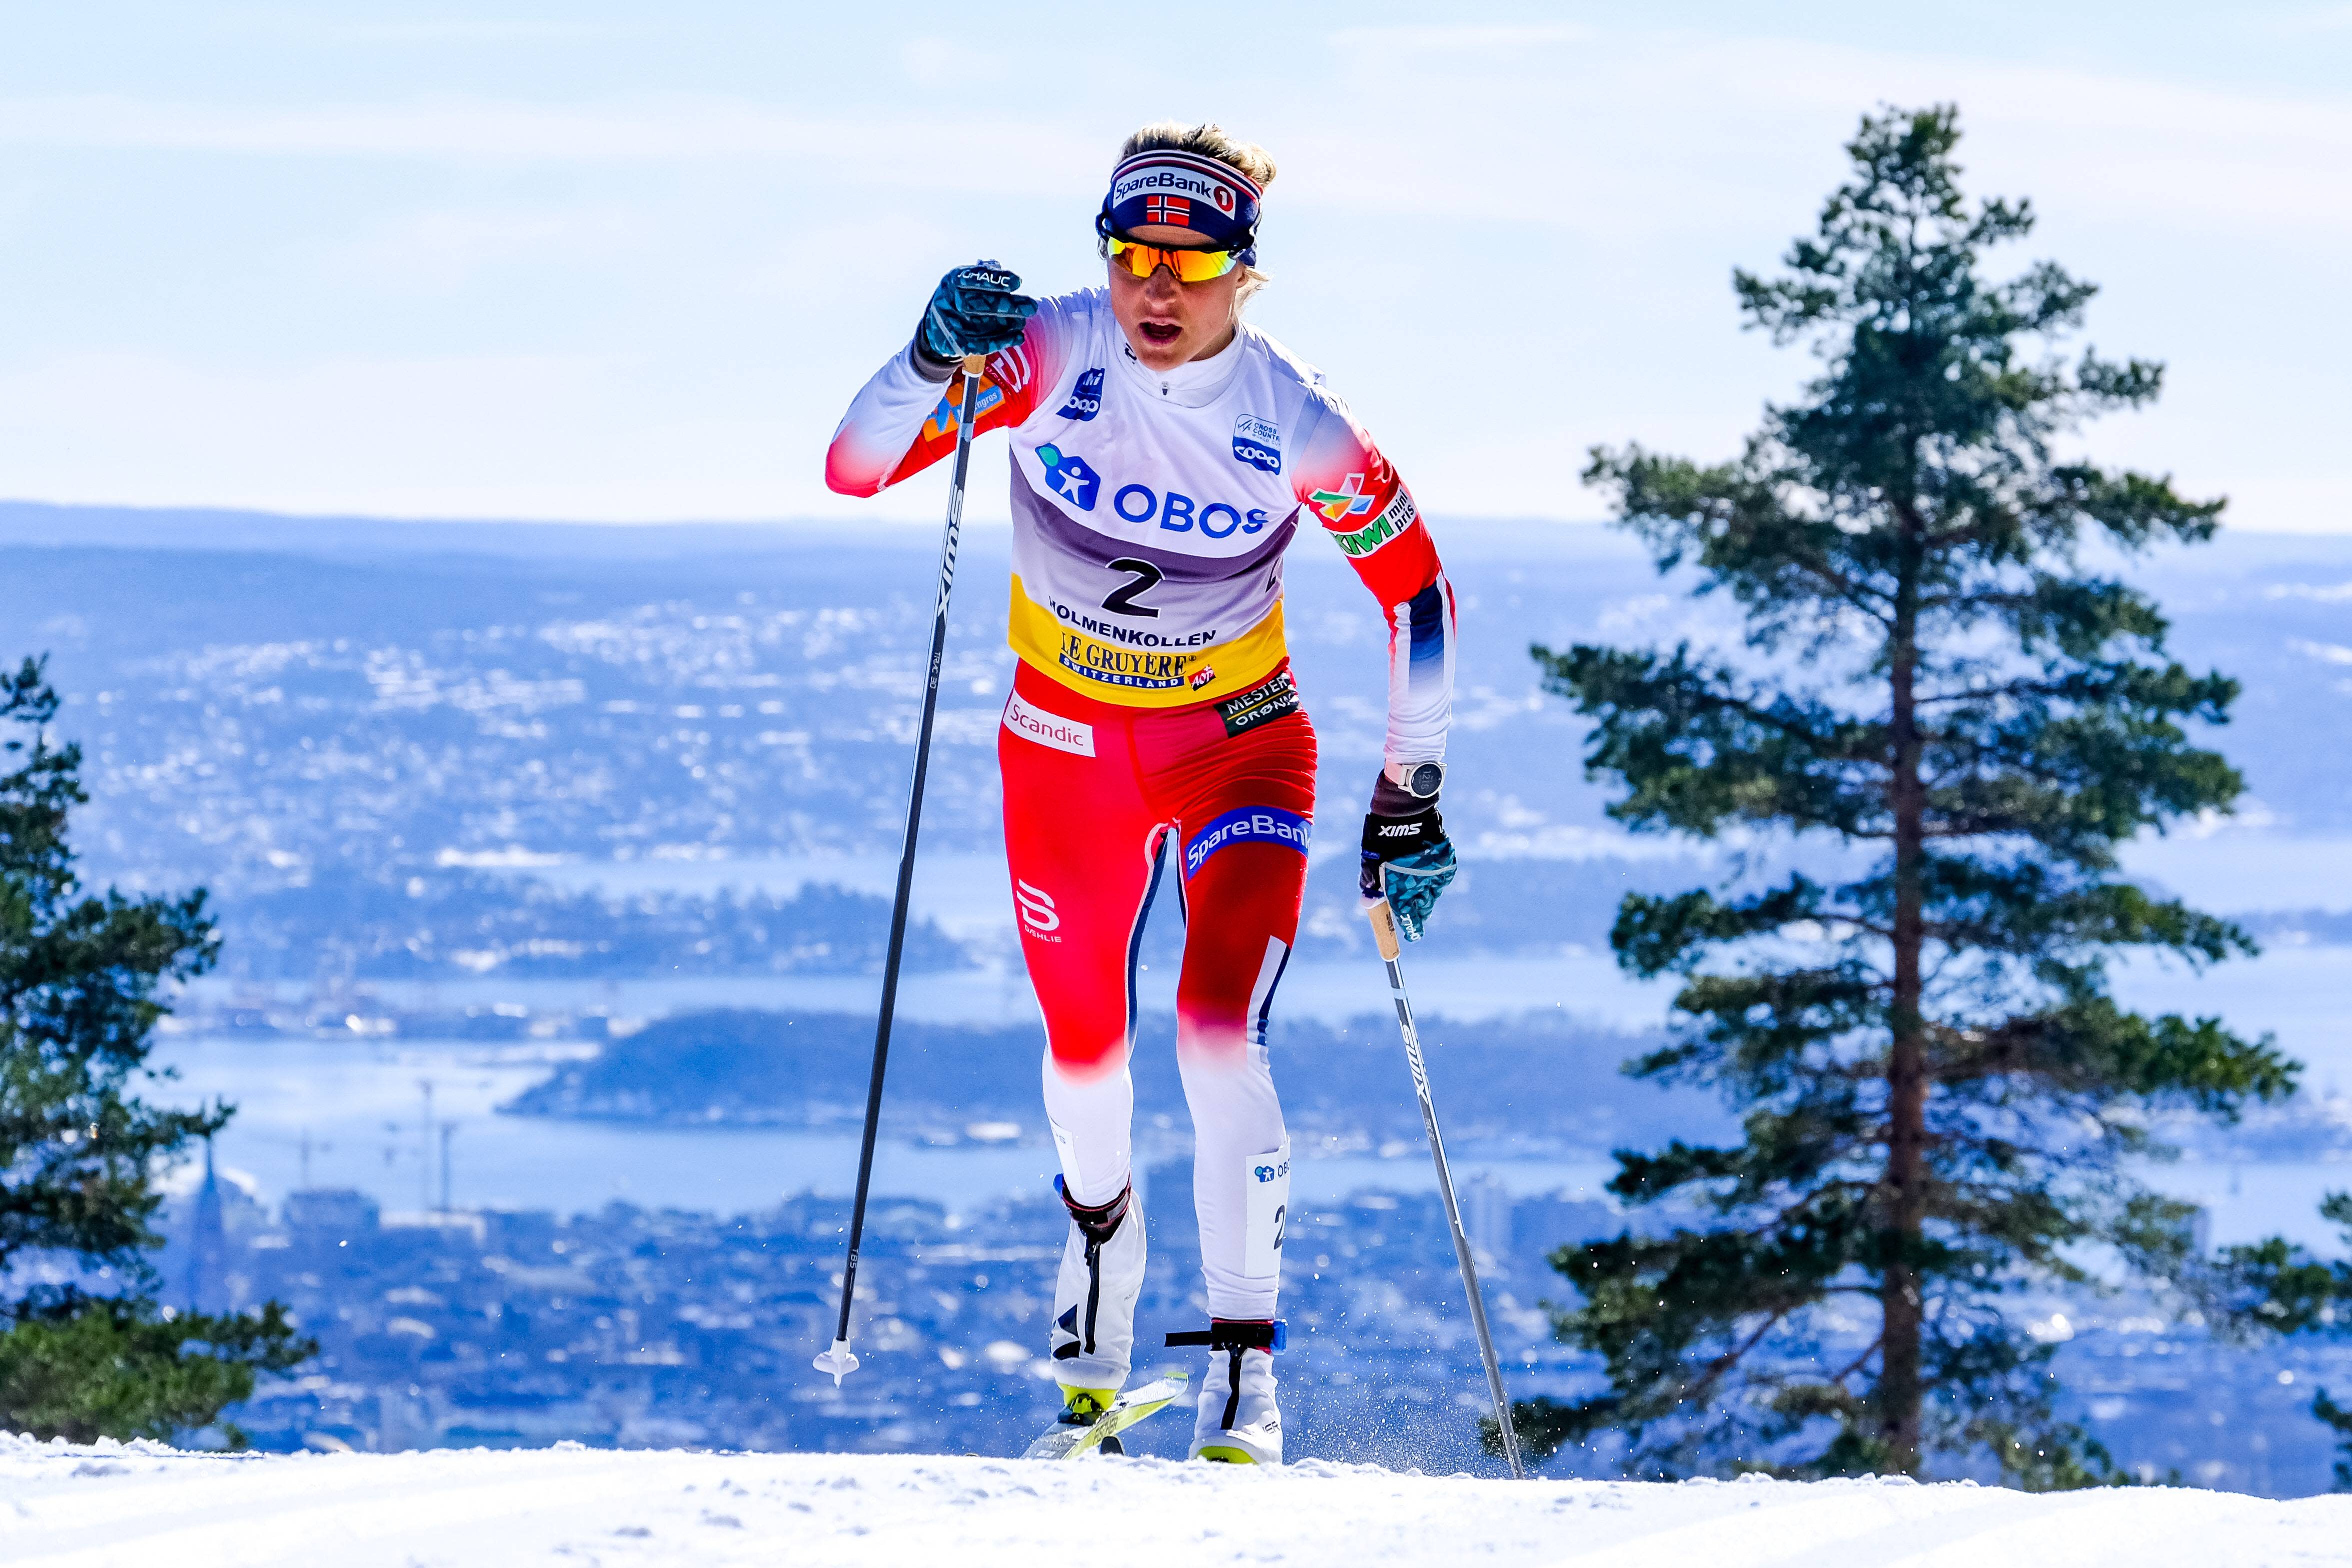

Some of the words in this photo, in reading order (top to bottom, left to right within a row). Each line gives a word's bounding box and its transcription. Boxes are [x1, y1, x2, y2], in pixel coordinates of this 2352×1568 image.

[1115, 172, 1212, 199] SpareBank
[1254, 423, 1277, 434] CROSS
[1234, 446, 1279, 468] coop
[1114, 483, 1268, 538] OBOS
[1388, 489, 1408, 519] mini
[1395, 504, 1414, 532] pris
[1335, 514, 1394, 555] KIWI
[1099, 557, 1166, 619] 2
[1049, 595, 1216, 647] HOLMENKOLLEN
[1060, 631, 1082, 660] LE
[1063, 657, 1179, 688] SWITZERLAND
[1226, 677, 1287, 715] MESTER
[1010, 704, 1084, 746] Scandic
[1188, 815, 1310, 870] SpareBank
